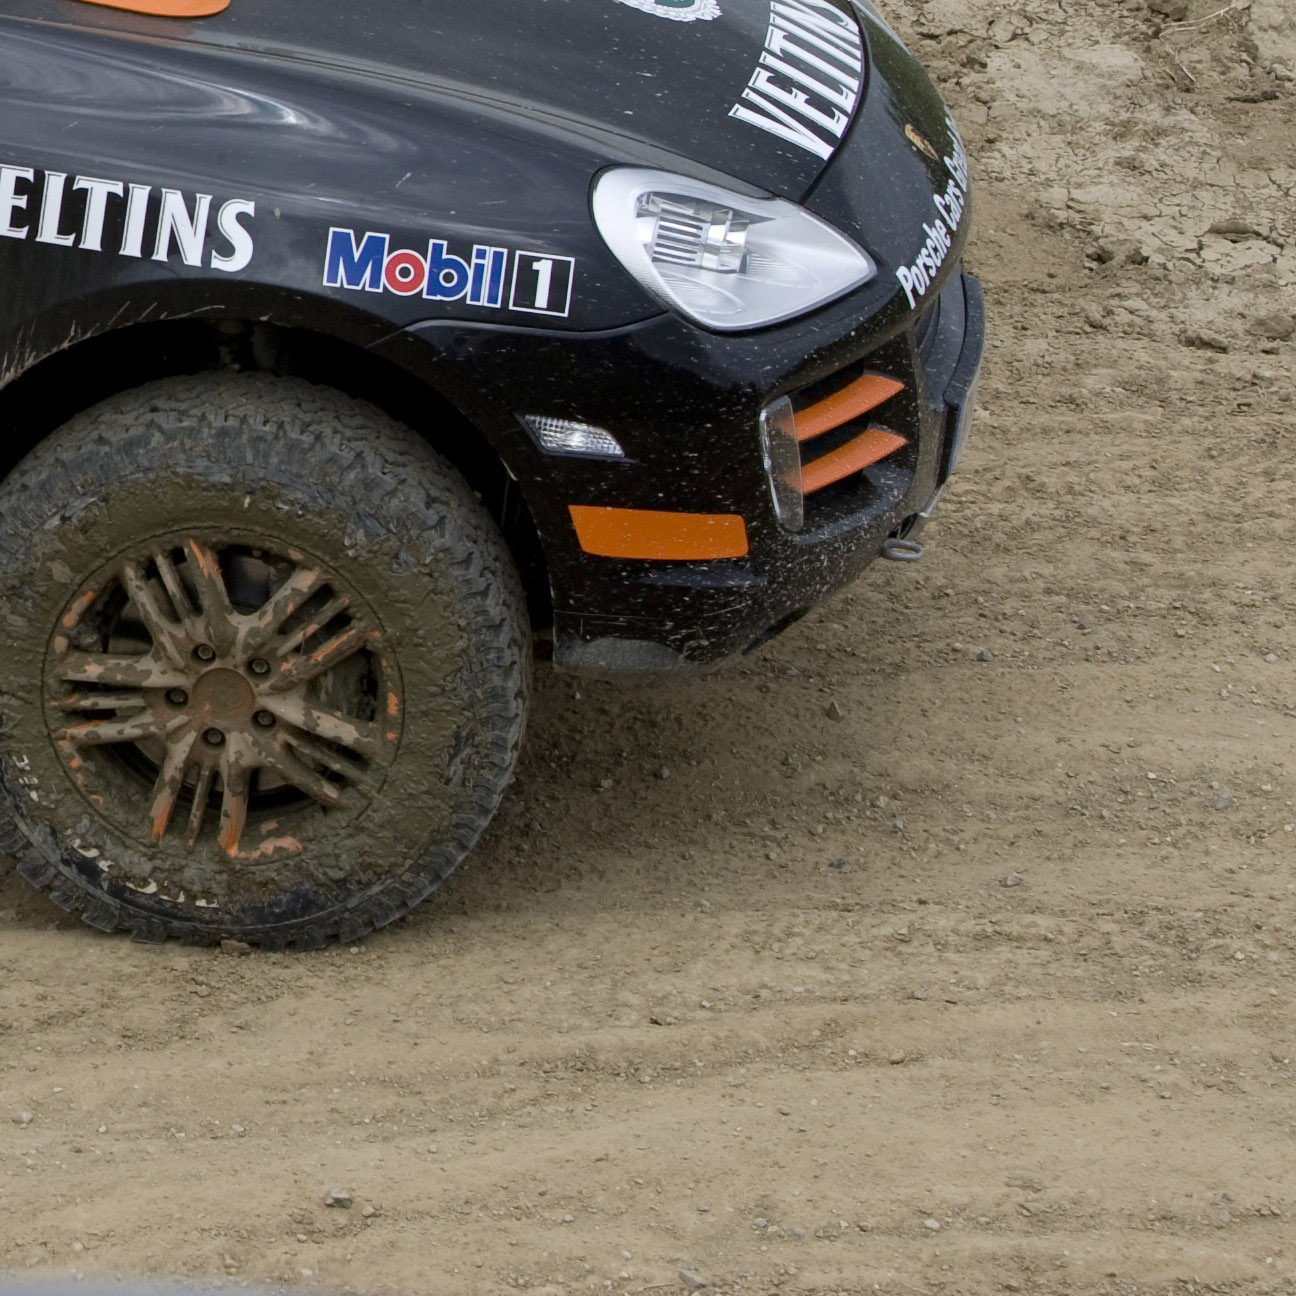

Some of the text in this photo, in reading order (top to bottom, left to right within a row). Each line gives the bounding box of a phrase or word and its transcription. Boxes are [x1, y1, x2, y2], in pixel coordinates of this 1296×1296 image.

[322, 226, 508, 309] Mobil
[895, 218, 952, 310] Porsche
[933, 179, 965, 232] Cars
